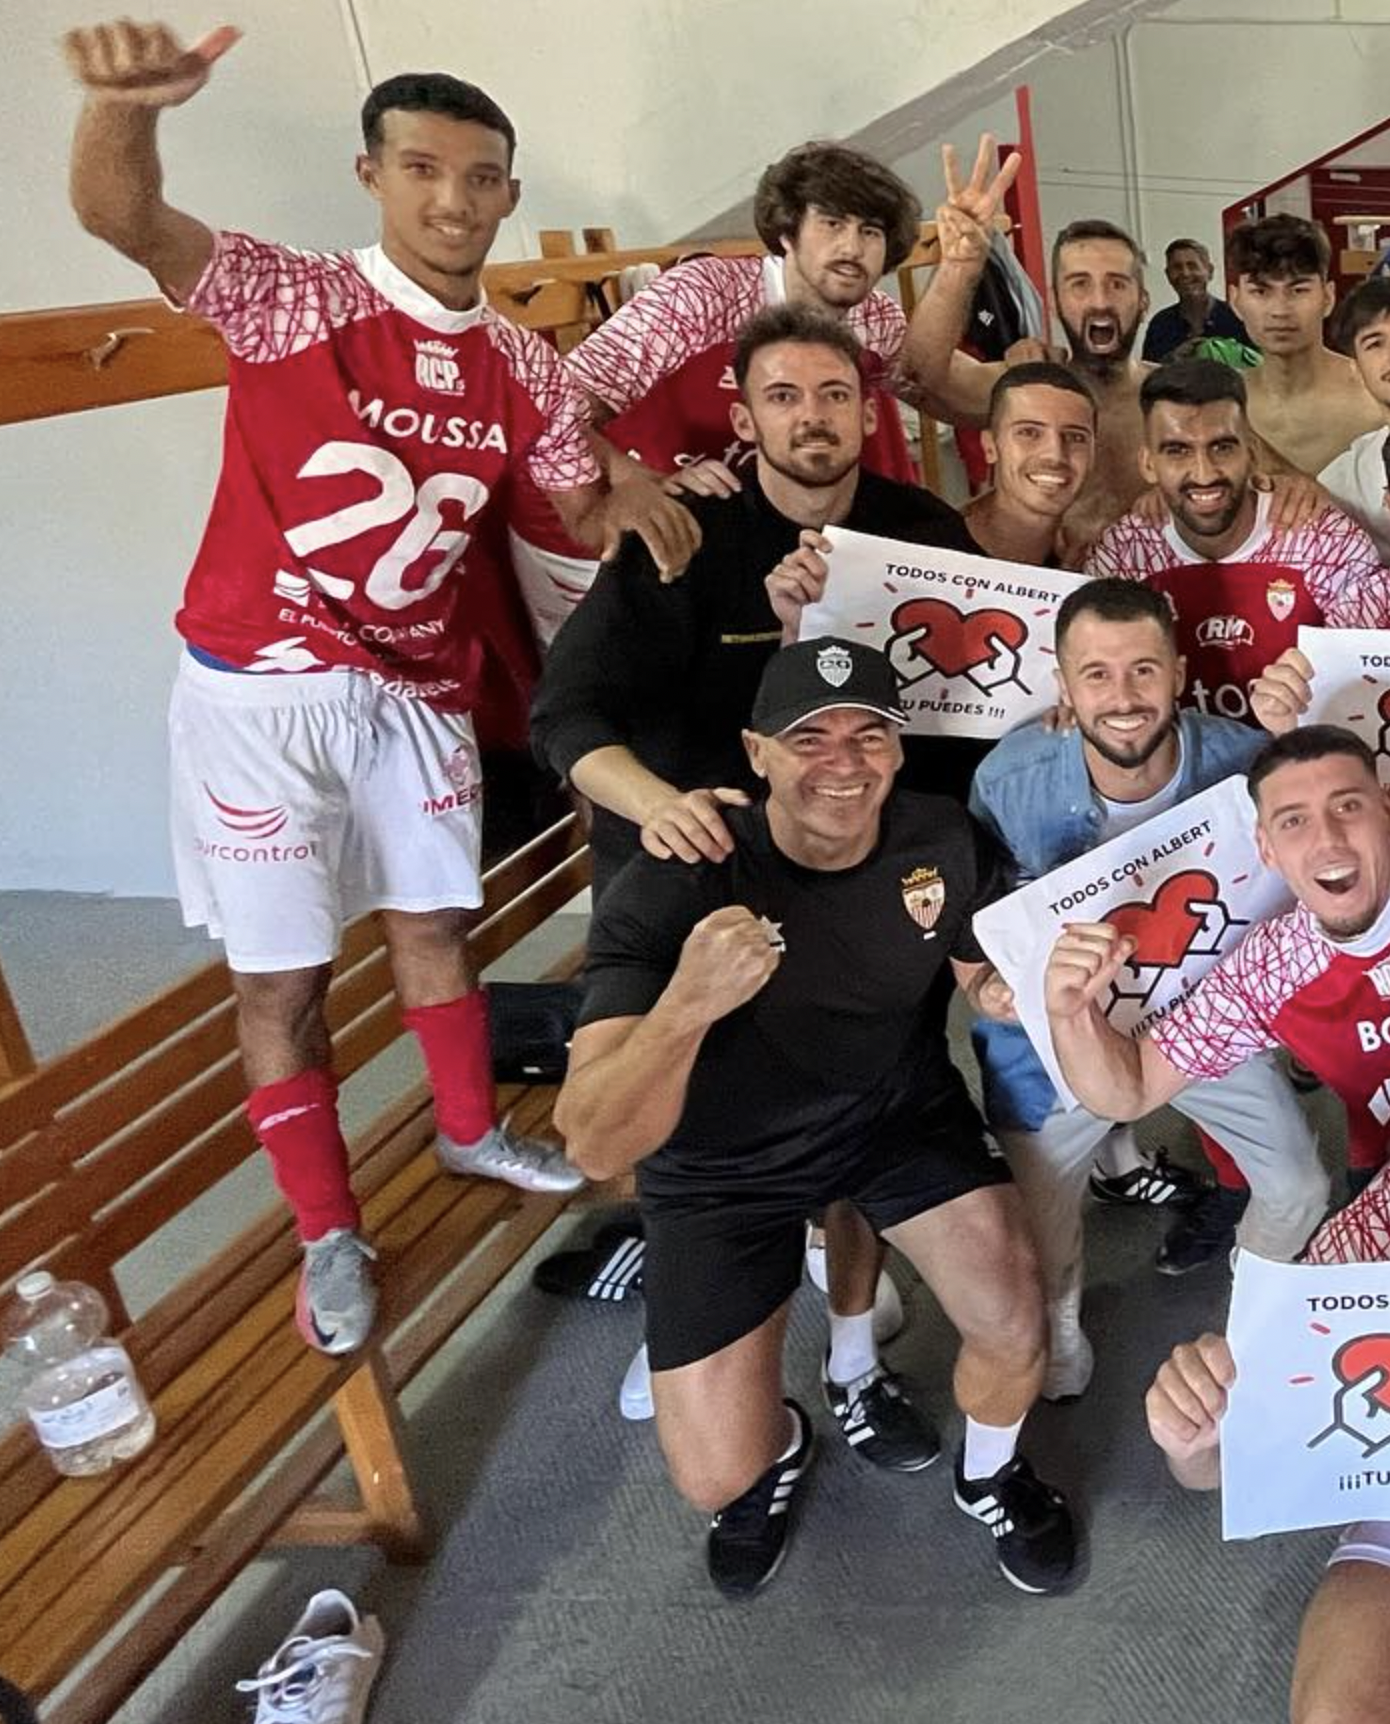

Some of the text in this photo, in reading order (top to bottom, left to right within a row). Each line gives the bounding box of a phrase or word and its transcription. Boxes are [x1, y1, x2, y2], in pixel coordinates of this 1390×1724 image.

[348, 389, 508, 454] MOUSSA
[283, 440, 489, 610] 26
[885, 563, 1061, 604] TODOS CON ALBERT
[919, 700, 984, 715] PUEDES
[988, 706, 1006, 718] !!!
[1049, 819, 1213, 916] TODOS CON ALBERT
[1306, 1293, 1389, 1312] TODOS
